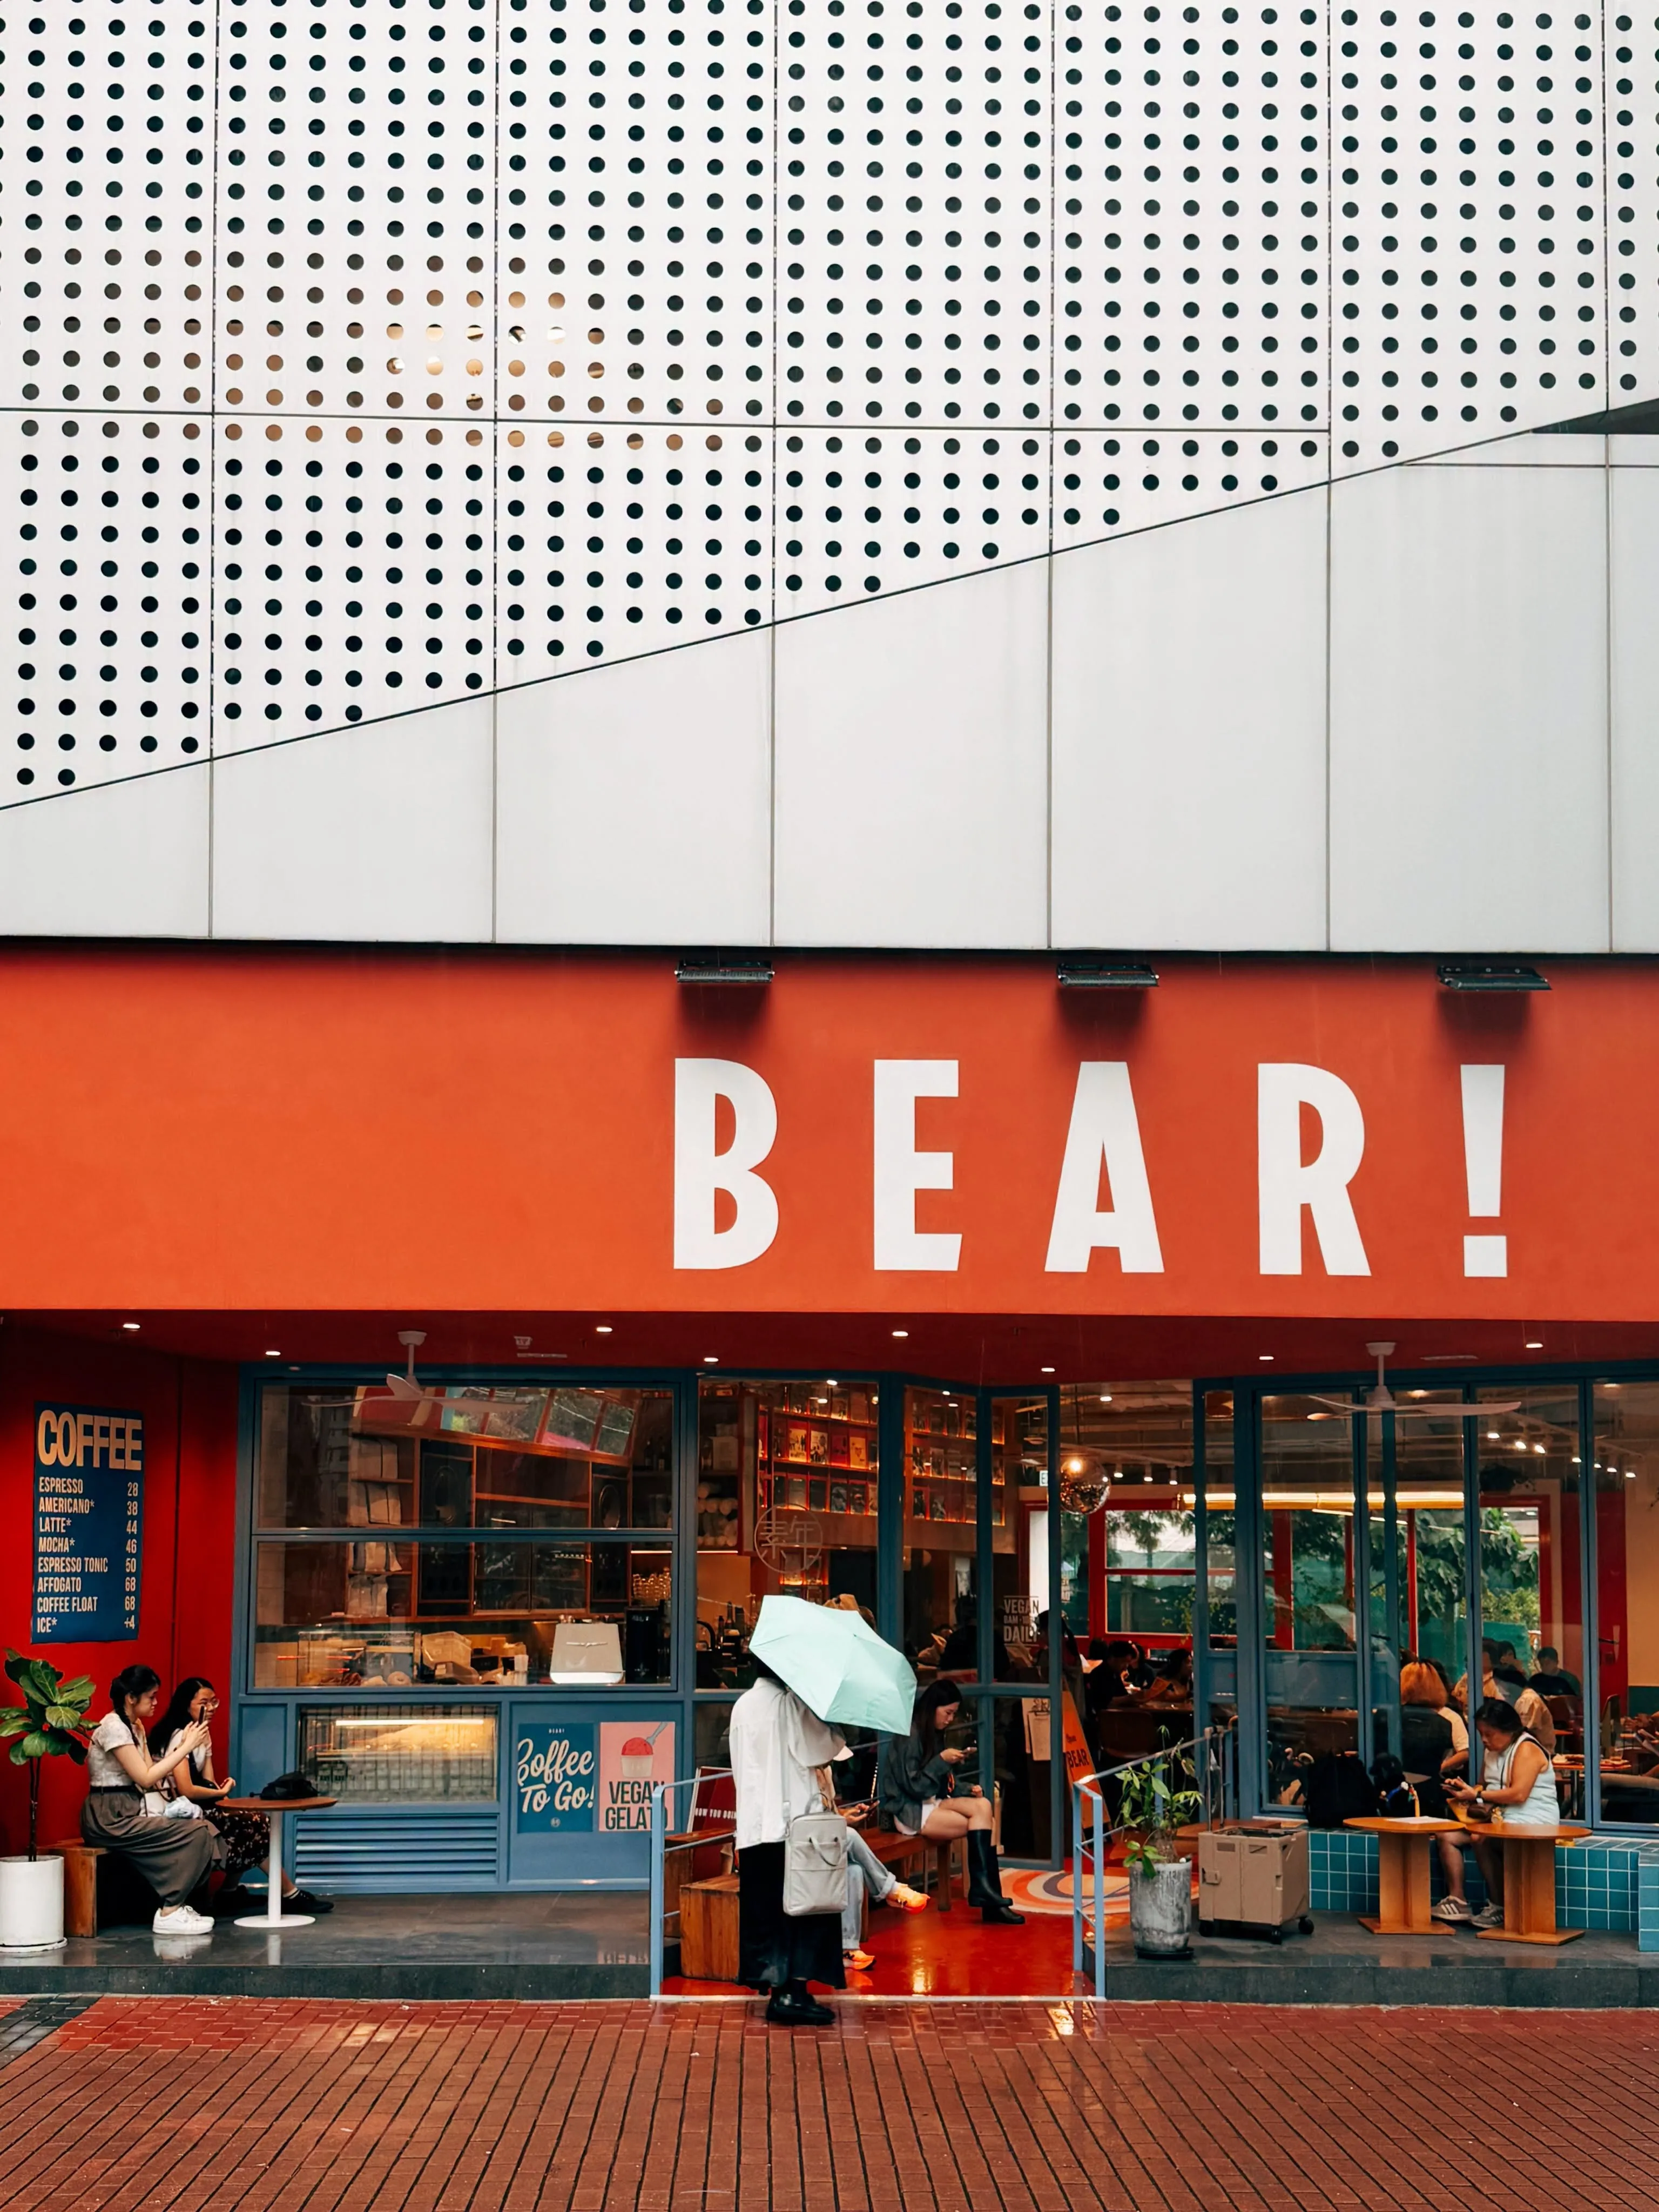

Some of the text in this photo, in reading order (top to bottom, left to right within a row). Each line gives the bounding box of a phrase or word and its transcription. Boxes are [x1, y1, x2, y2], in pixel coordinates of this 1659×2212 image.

[673, 1057, 1508, 1278] BEAR!
[38, 1410, 142, 1471] COFFEE
[39, 1477, 138, 1497] ESPRESSO 28
[127, 1501, 138, 1516] 38
[126, 1520, 137, 1534] 44
[126, 1539, 137, 1554] 46
[38, 1557, 136, 1573] ESPRESSO TONIC 50
[37, 1577, 136, 1593] AFFOGATO 68
[37, 1596, 136, 1613] COFFEE FLOAT 68
[1004, 1599, 1038, 1614] VEGAN
[124, 1615, 135, 1629] +4
[1003, 1626, 1037, 1642] DAILY
[521, 1783, 550, 1813] To
[605, 1807, 668, 1830] GELA
